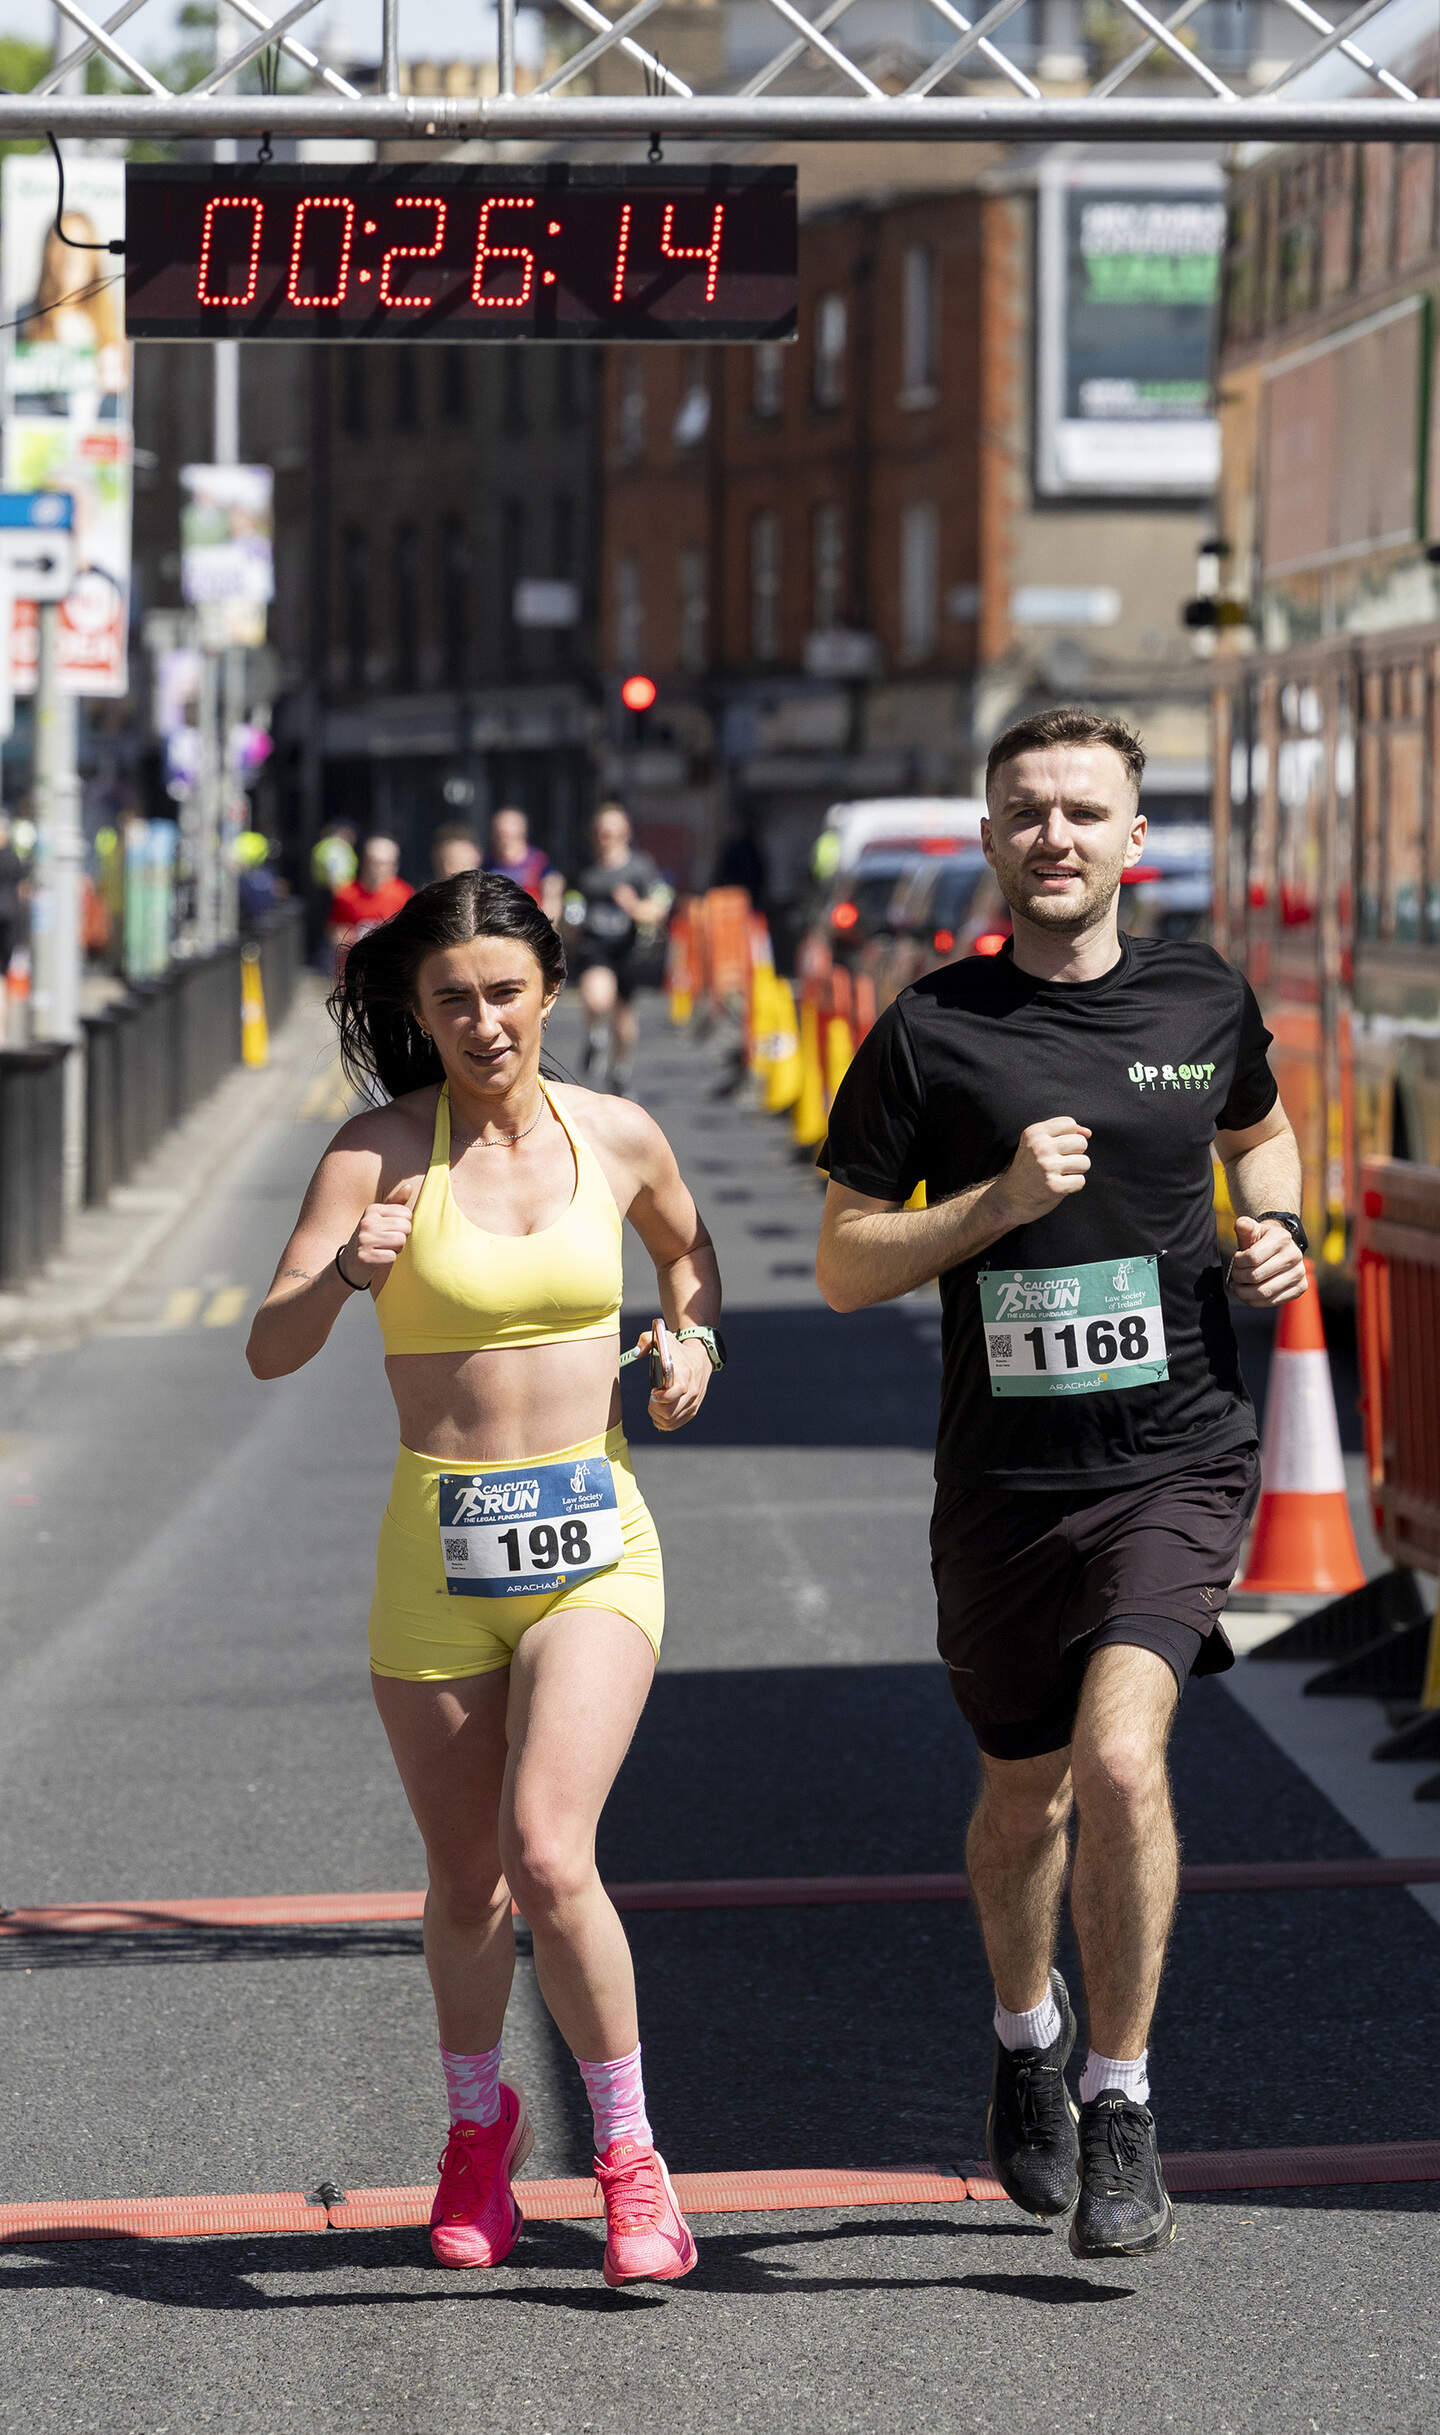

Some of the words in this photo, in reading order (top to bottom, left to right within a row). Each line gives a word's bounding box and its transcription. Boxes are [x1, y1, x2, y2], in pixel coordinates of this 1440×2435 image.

[1127, 1061, 1158, 1083] UP
[1138, 1080, 1210, 1092] FITNESS
[1023, 1277, 1080, 1290] CALCUTTA
[1024, 1286, 1081, 1311] RUN
[1121, 1290, 1146, 1300] Society
[1108, 1302, 1116, 1311] of
[1117, 1299, 1143, 1309] Ireland
[1023, 1315, 1149, 1371] 1168
[1048, 1379, 1099, 1392] ARACHAS
[482, 1479, 539, 1494] CALCUTTA
[482, 1488, 541, 1514] RUN
[561, 1497, 578, 1505] Law
[578, 1493, 604, 1502] Society
[565, 1503, 573, 1513] of
[574, 1501, 600, 1511] Ireland
[476, 1515, 497, 1523] LEGAL
[497, 1511, 538, 1521] FUNDRAISER
[497, 1519, 592, 1572] 198
[506, 1580, 559, 1593] ARACHAS
